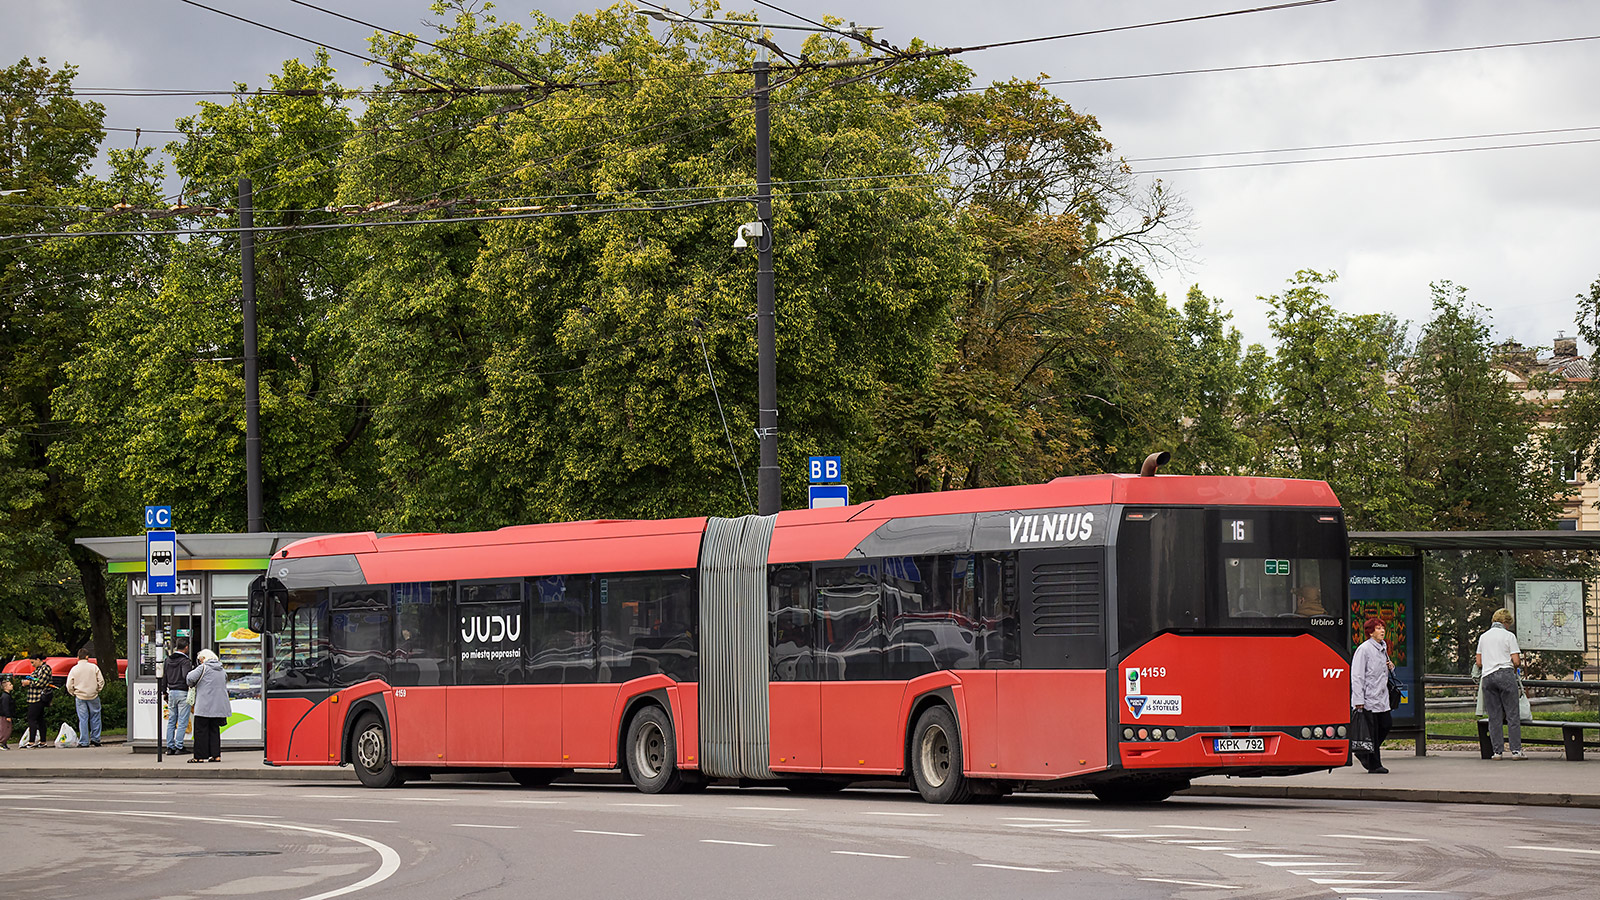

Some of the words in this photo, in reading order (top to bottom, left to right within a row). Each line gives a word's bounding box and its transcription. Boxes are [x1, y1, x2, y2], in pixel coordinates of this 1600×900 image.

[811, 460, 822, 479] B
[825, 460, 839, 479] B
[146, 509, 154, 525] C
[155, 508, 169, 525] C
[1009, 512, 1094, 544] VILNIUS
[1230, 520, 1245, 541] 16
[461, 614, 521, 643] JUDU
[1310, 618, 1335, 626] Urbino
[461, 652, 470, 661] po
[491, 647, 521, 661] paprastai
[1140, 667, 1166, 678] 4159
[1322, 668, 1345, 679] VVT
[395, 688, 407, 698] 4159
[1219, 739, 1241, 750] KPK
[1245, 739, 1263, 750] 792
